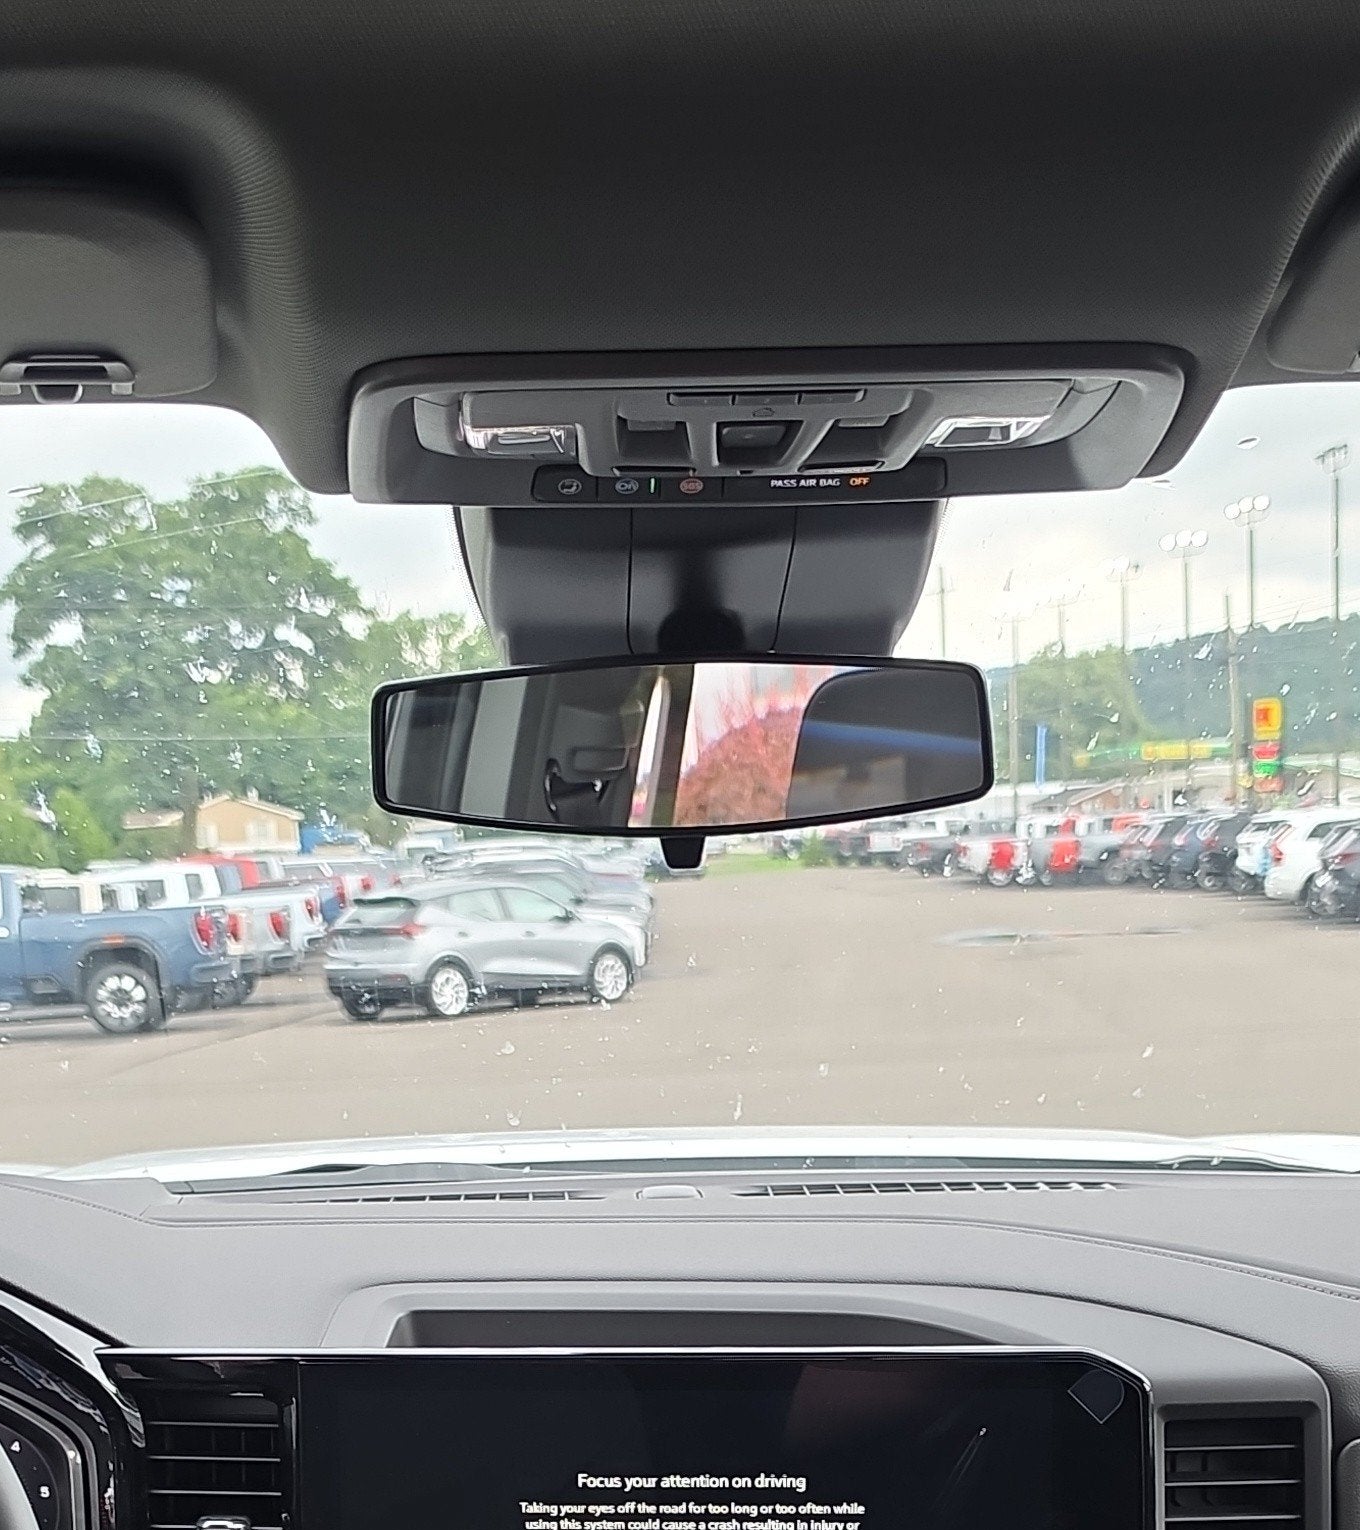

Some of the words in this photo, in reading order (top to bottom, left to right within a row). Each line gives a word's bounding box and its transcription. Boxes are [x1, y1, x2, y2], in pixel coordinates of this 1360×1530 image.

[770, 479, 797, 487] PASS
[799, 478, 817, 487] AIR
[819, 478, 840, 487] BAG
[849, 477, 871, 486] OFF
[11, 1441, 21, 1452] 4
[577, 1473, 622, 1488] Focus
[624, 1476, 658, 1492] your
[660, 1474, 729, 1488] attention
[732, 1477, 752, 1488] on
[754, 1473, 806, 1492] driving
[39, 1486, 50, 1499] 5
[519, 1501, 558, 1516] Taking
[560, 1504, 587, 1516] your
[588, 1504, 616, 1517] eyes
[617, 1502, 636, 1514] off
[637, 1502, 657, 1514] the
[659, 1502, 686, 1514] road
[688, 1502, 706, 1514] for
[708, 1503, 729, 1514] too
[731, 1502, 758, 1517] long
[759, 1505, 774, 1514] or
[775, 1503, 796, 1514] too
[798, 1502, 832, 1515] often
[833, 1502, 866, 1515] while
[560, 1518, 582, 1530] this
[627, 1519, 660, 1530] could
[662, 1520, 697, 1530] cause
[698, 1521, 706, 1530] a
[707, 1519, 740, 1530] crash
[796, 1520, 808, 1530] in
[846, 1521, 861, 1530] or
